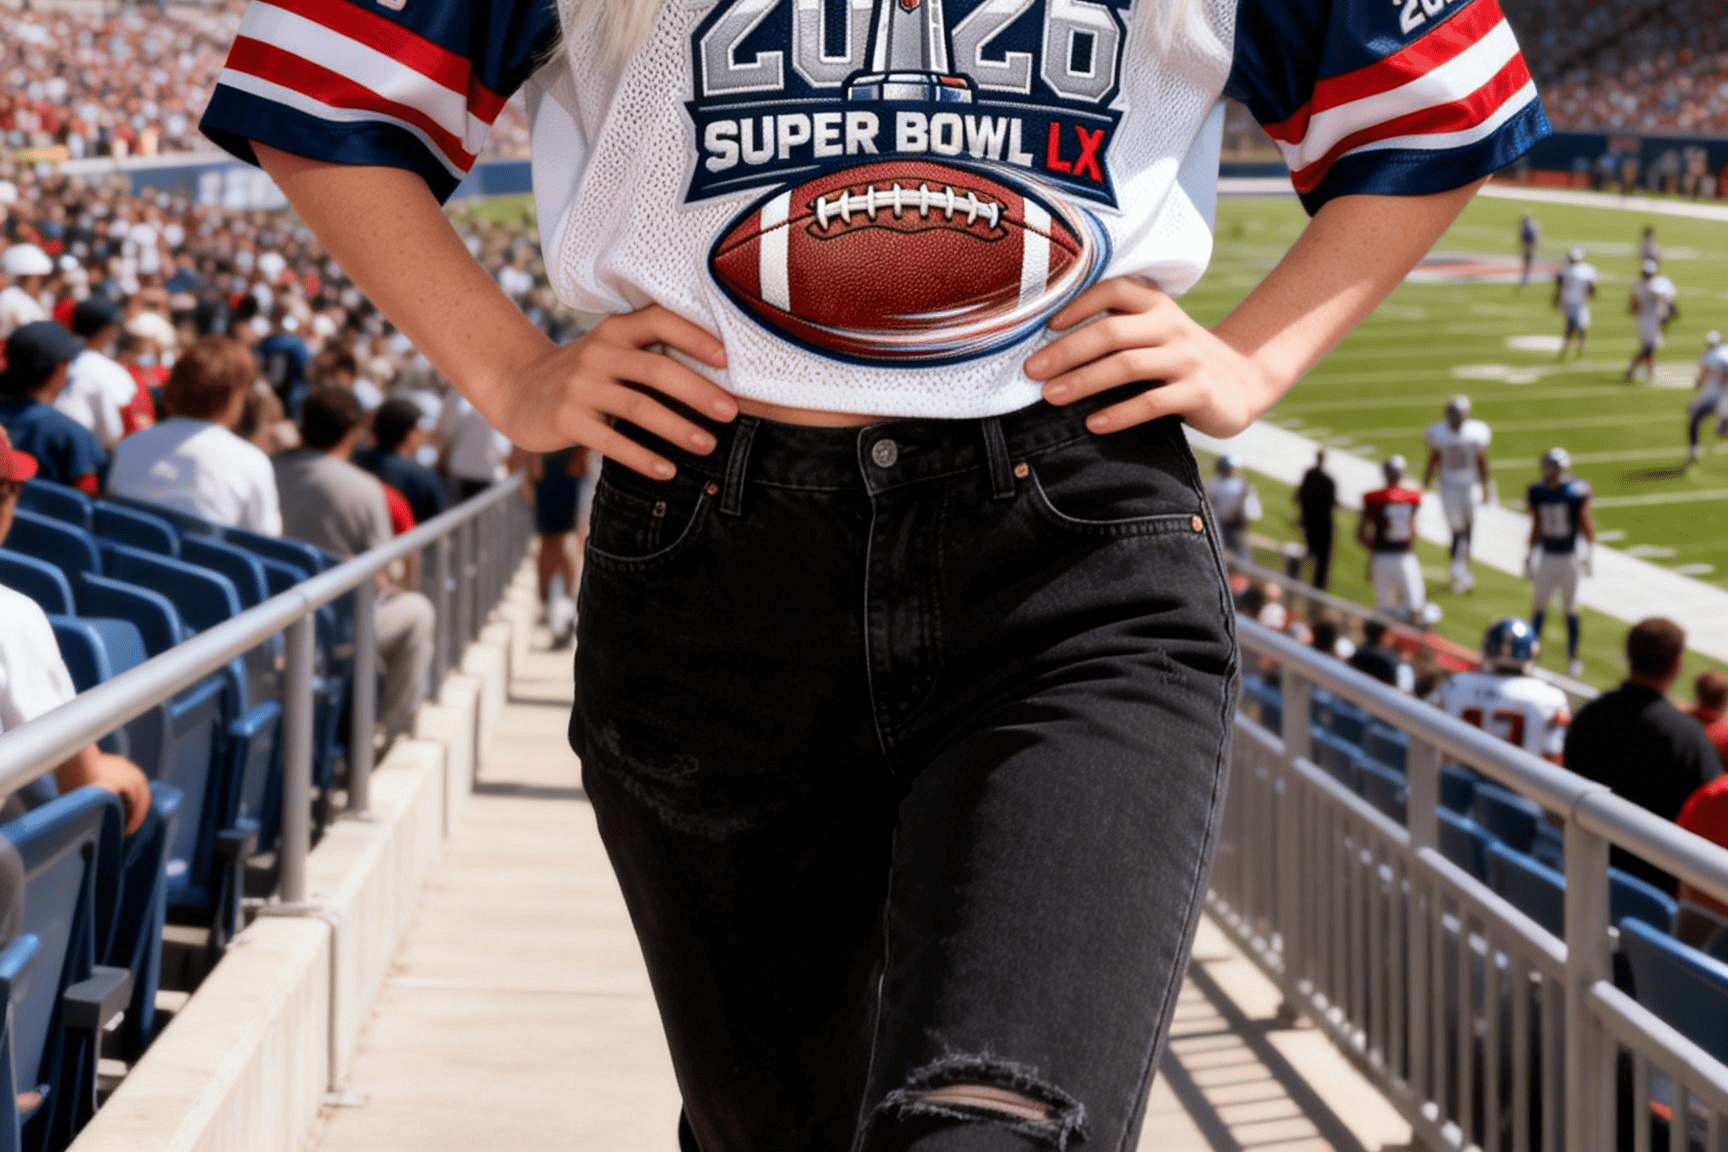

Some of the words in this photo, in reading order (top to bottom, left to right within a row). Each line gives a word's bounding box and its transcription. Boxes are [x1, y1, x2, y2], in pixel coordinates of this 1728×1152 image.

[704, 111, 879, 173] SUPER
[896, 111, 1033, 166] BOWL
[1046, 121, 1105, 182] LX
